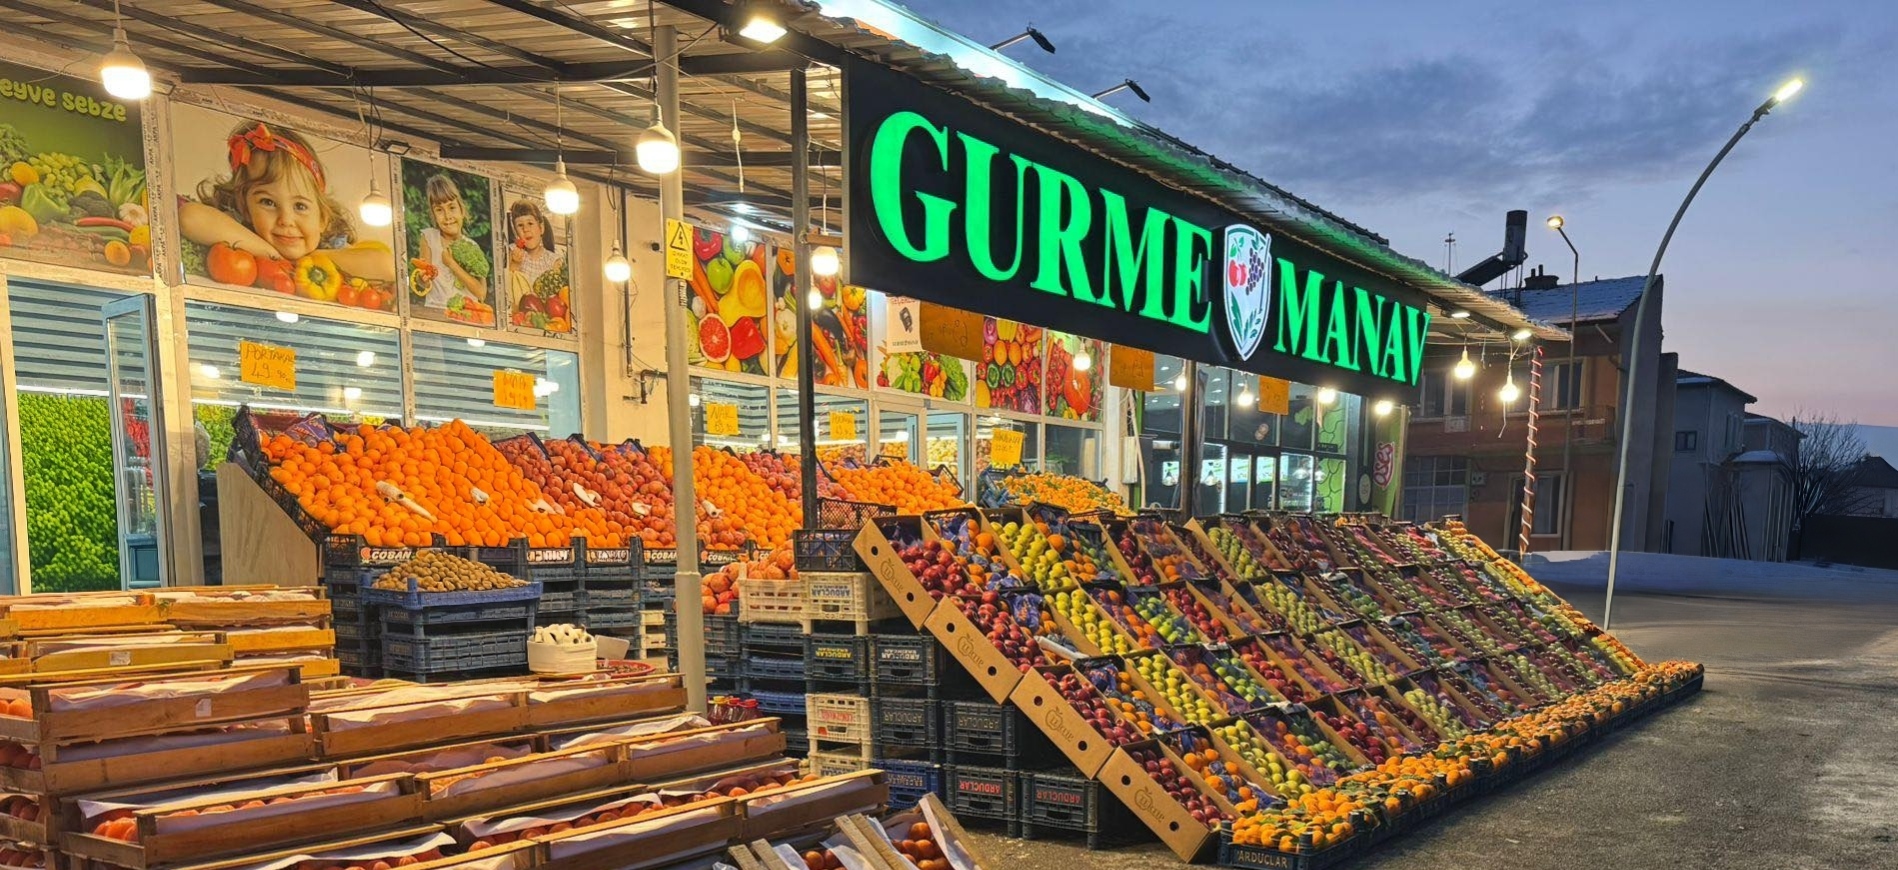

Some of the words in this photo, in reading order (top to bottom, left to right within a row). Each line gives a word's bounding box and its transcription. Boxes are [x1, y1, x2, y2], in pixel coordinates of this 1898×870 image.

[62, 92, 127, 122] sebze
[870, 111, 1212, 334] GURME
[1273, 257, 1431, 387] MANAV
